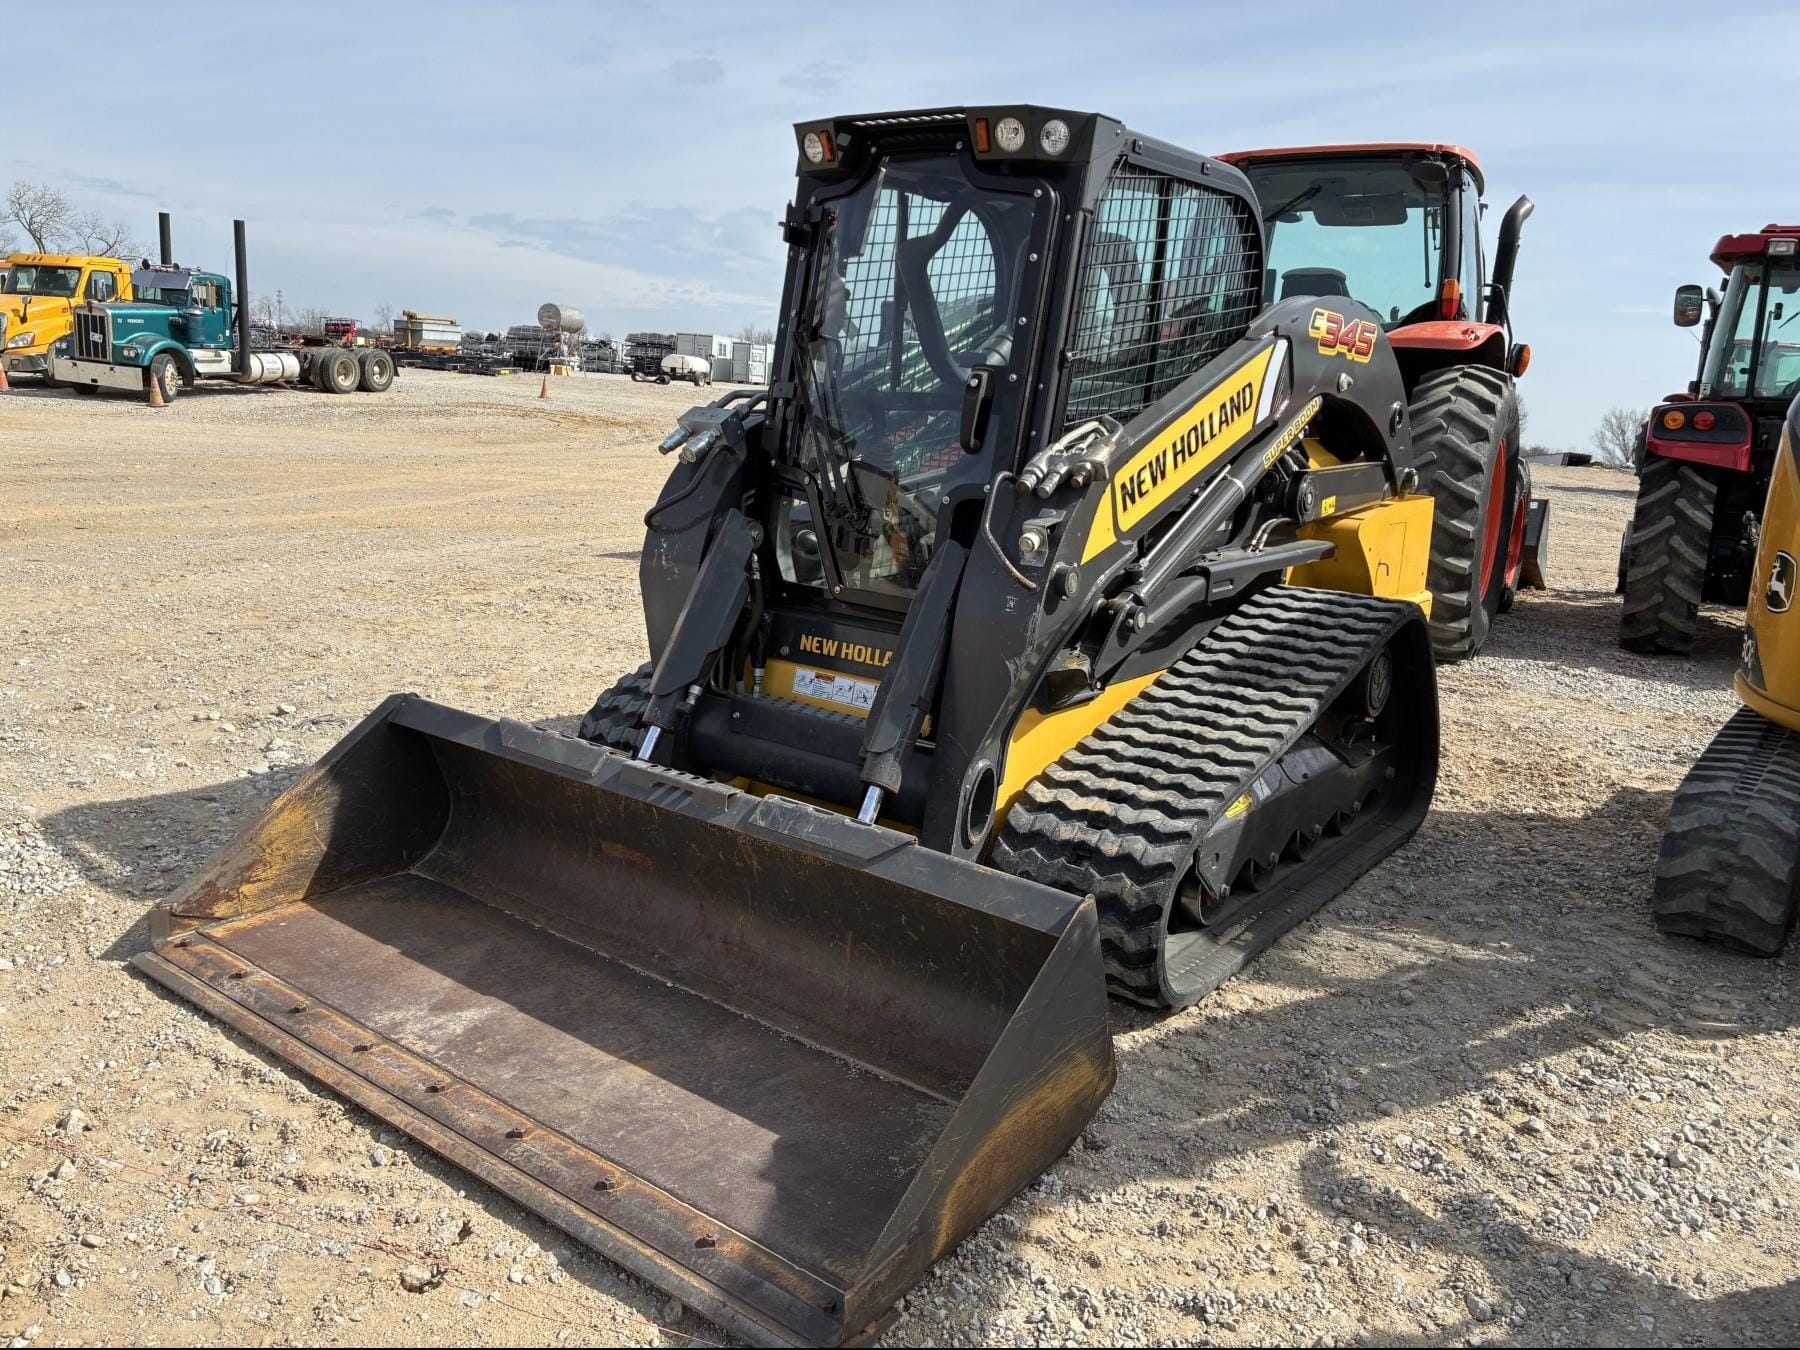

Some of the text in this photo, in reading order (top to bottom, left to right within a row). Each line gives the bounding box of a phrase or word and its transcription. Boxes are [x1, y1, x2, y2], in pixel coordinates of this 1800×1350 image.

[1309, 307, 1377, 363] C345
[1119, 381, 1254, 513] NEW HOLLAND
[1263, 397, 1320, 469] SUPER BOOM
[799, 634, 893, 668] NEW HOLLA
